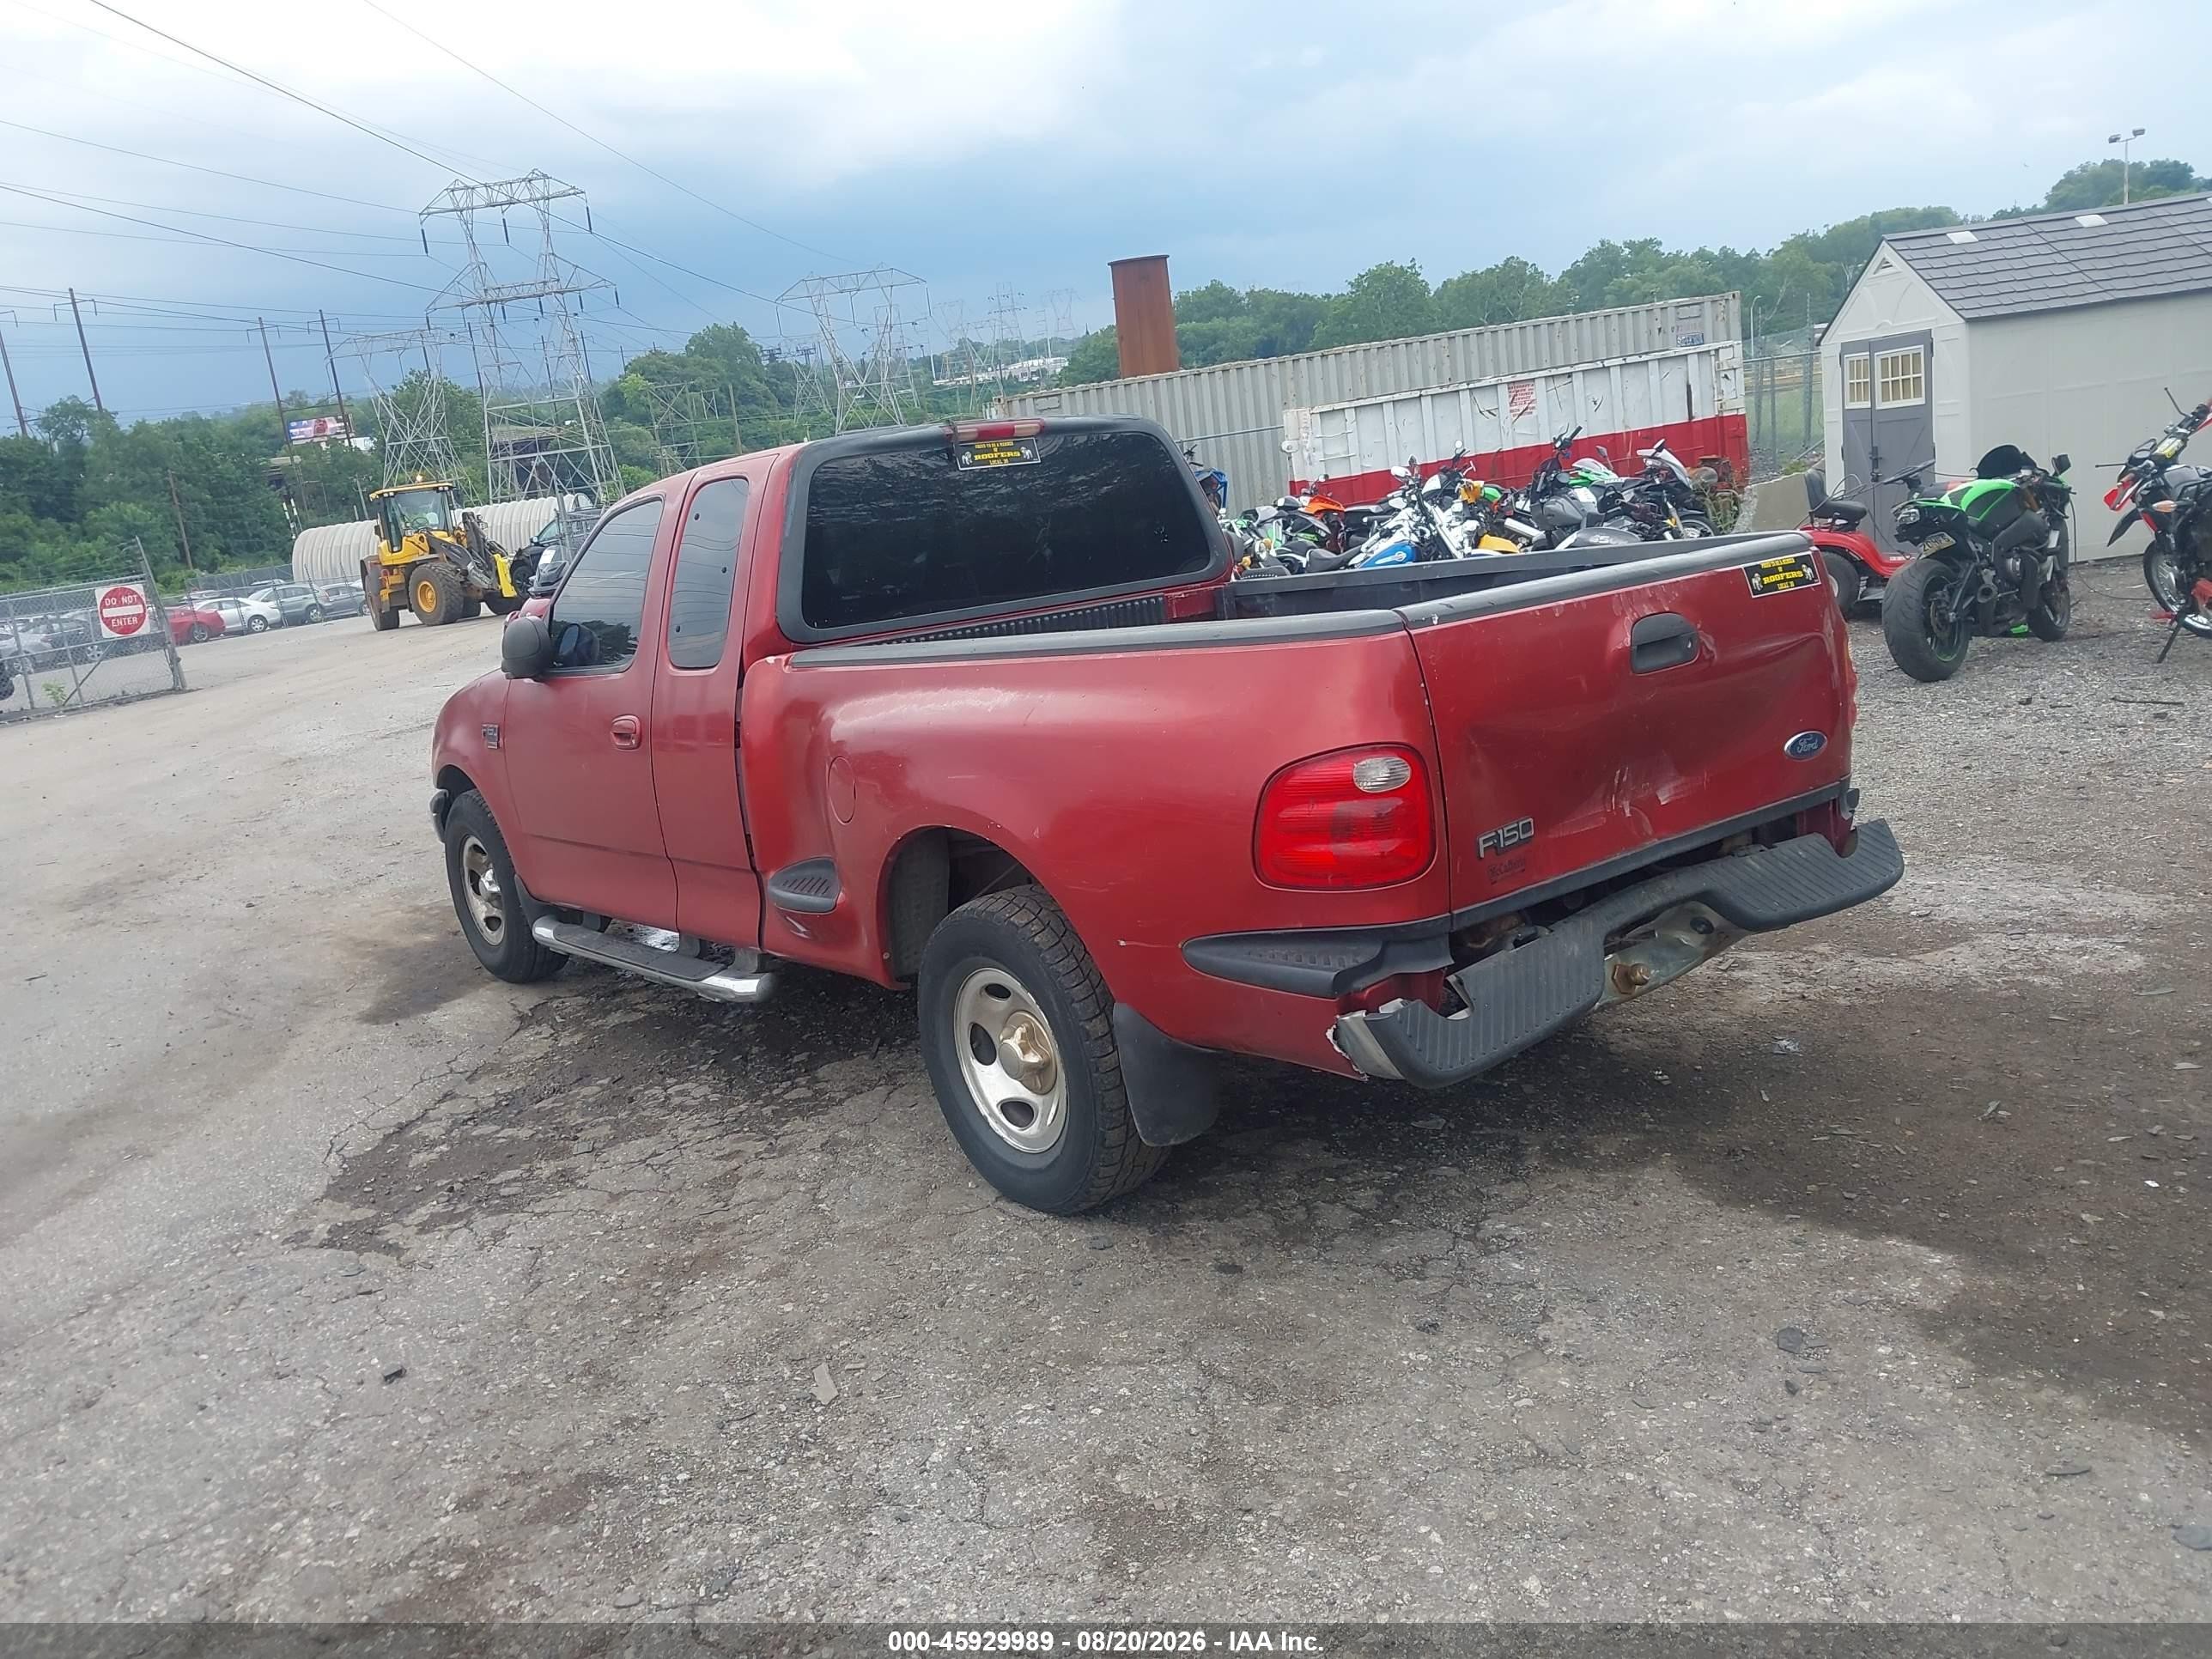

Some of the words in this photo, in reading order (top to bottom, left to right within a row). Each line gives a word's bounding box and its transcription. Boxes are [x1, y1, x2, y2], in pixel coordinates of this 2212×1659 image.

[974, 451, 1021, 461] ROOFERS
[1762, 570, 1804, 585] ROOFERS
[104, 598, 117, 606] DO
[121, 595, 137, 605] NOT
[111, 617, 138, 627] ENTER
